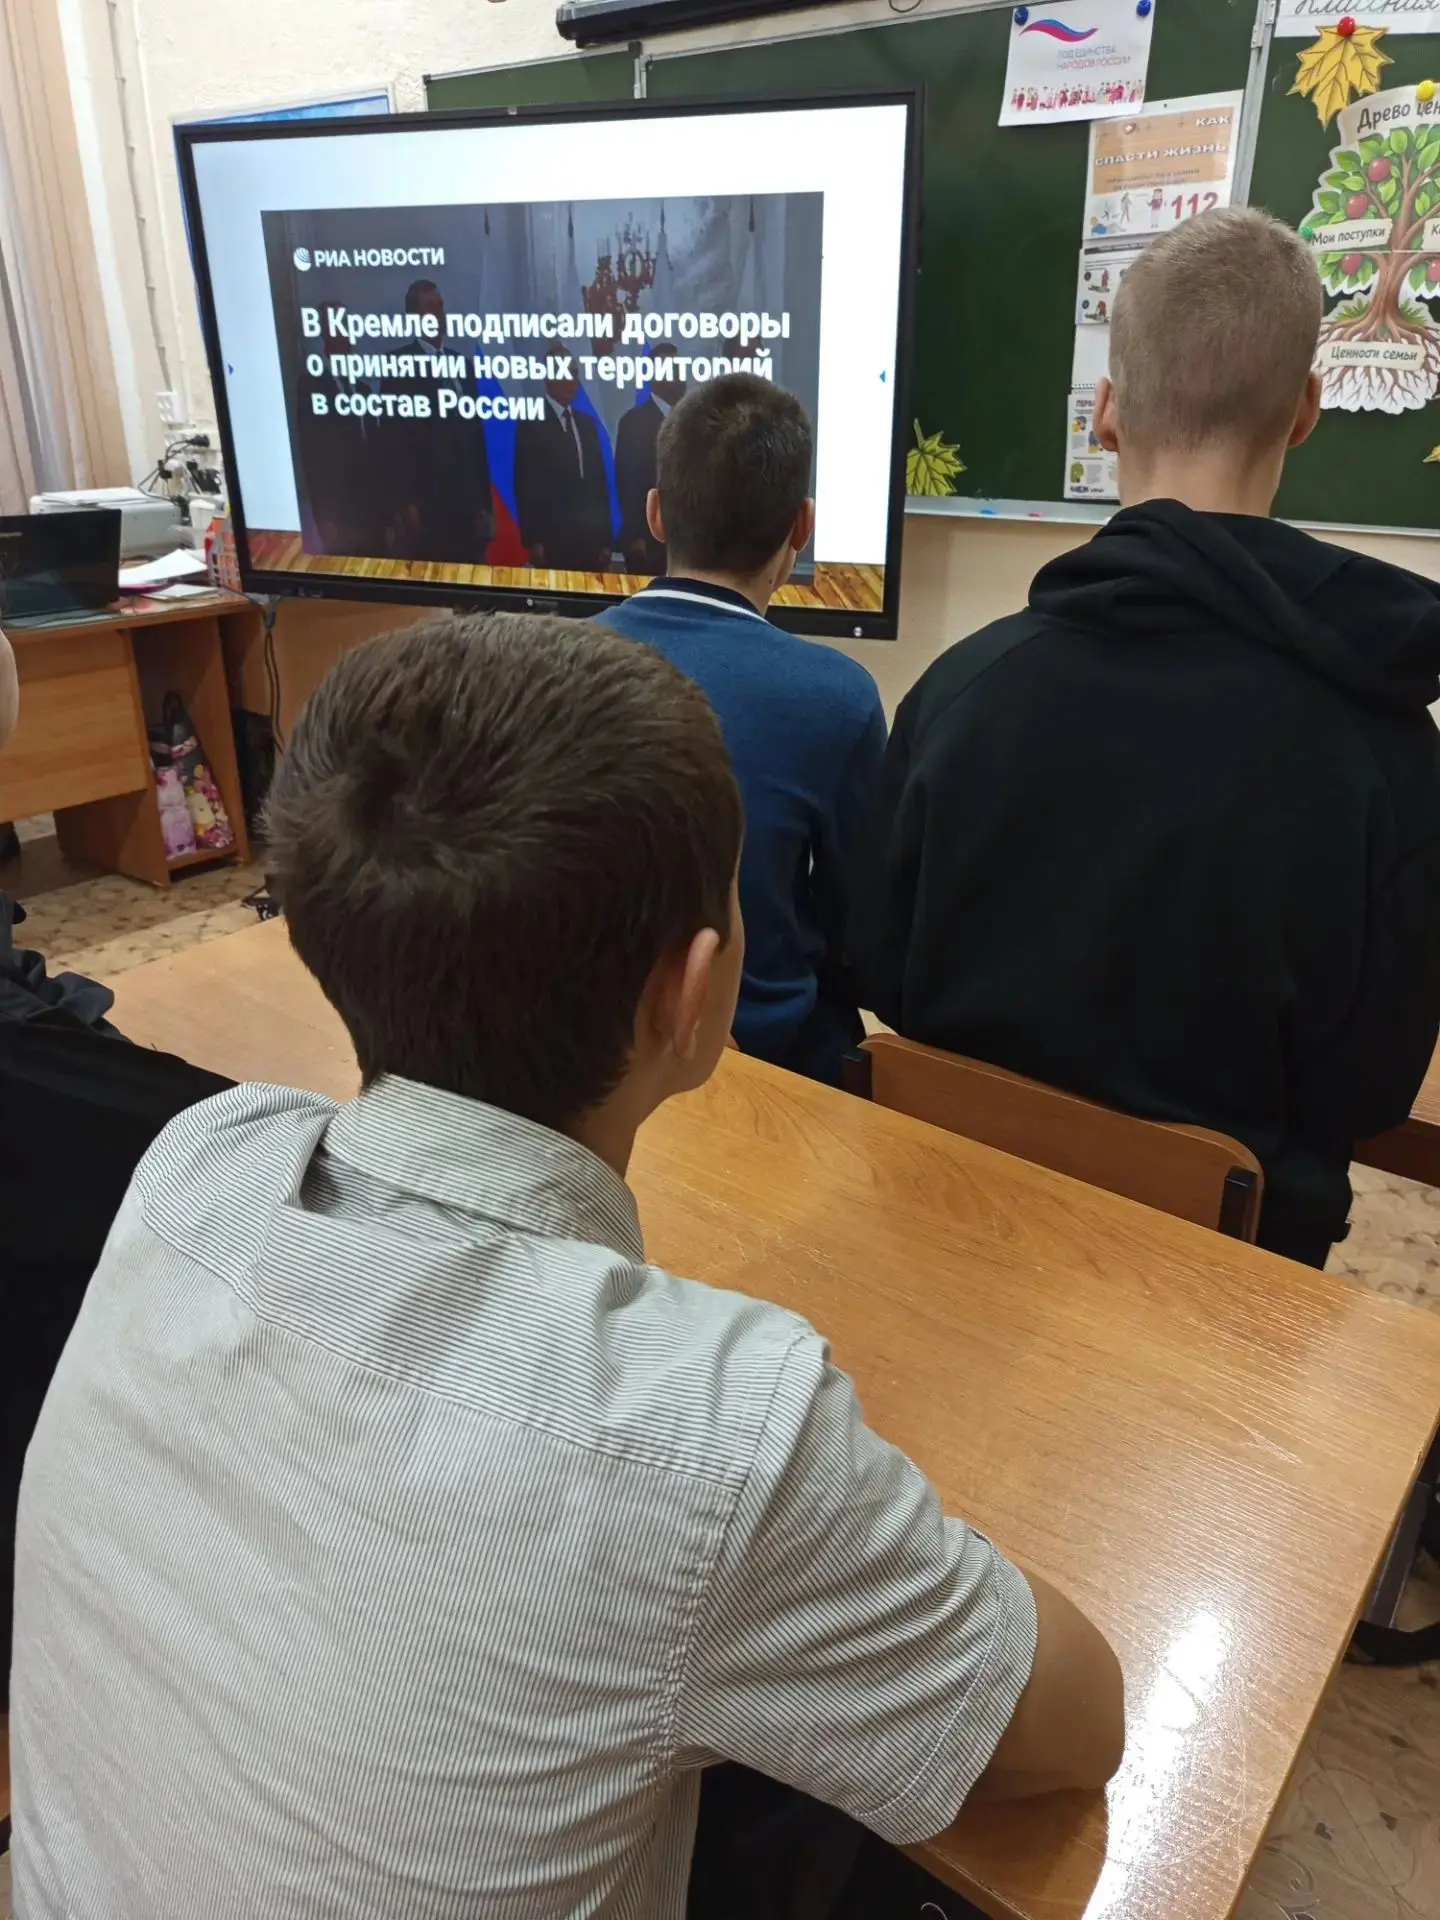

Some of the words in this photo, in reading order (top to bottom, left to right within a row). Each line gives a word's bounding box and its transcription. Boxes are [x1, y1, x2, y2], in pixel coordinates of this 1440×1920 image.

[1196, 115, 1232, 127] КАК
[1357, 104, 1410, 133] Древо
[1095, 151, 1158, 166] СПАСТИ
[1163, 143, 1228, 157] ЖИЗНЬ
[1171, 191, 1219, 219] 112
[1311, 232, 1335, 246] Мои
[1338, 227, 1385, 243] поступки
[314, 250, 352, 268] РИА
[353, 248, 445, 267] НОВОСТИ
[301, 307, 321, 338] В
[327, 307, 439, 345] Кремле
[446, 312, 613, 344] подписали
[621, 311, 790, 347] договоры
[1331, 346, 1380, 360] Ценности
[1383, 349, 1418, 361] семьи
[306, 354, 323, 377] о
[330, 354, 467, 384] принятии
[473, 355, 573, 380] новых
[580, 348, 773, 389] территорий
[311, 393, 329, 415] в
[334, 393, 432, 418] состав
[437, 389, 545, 421] России
